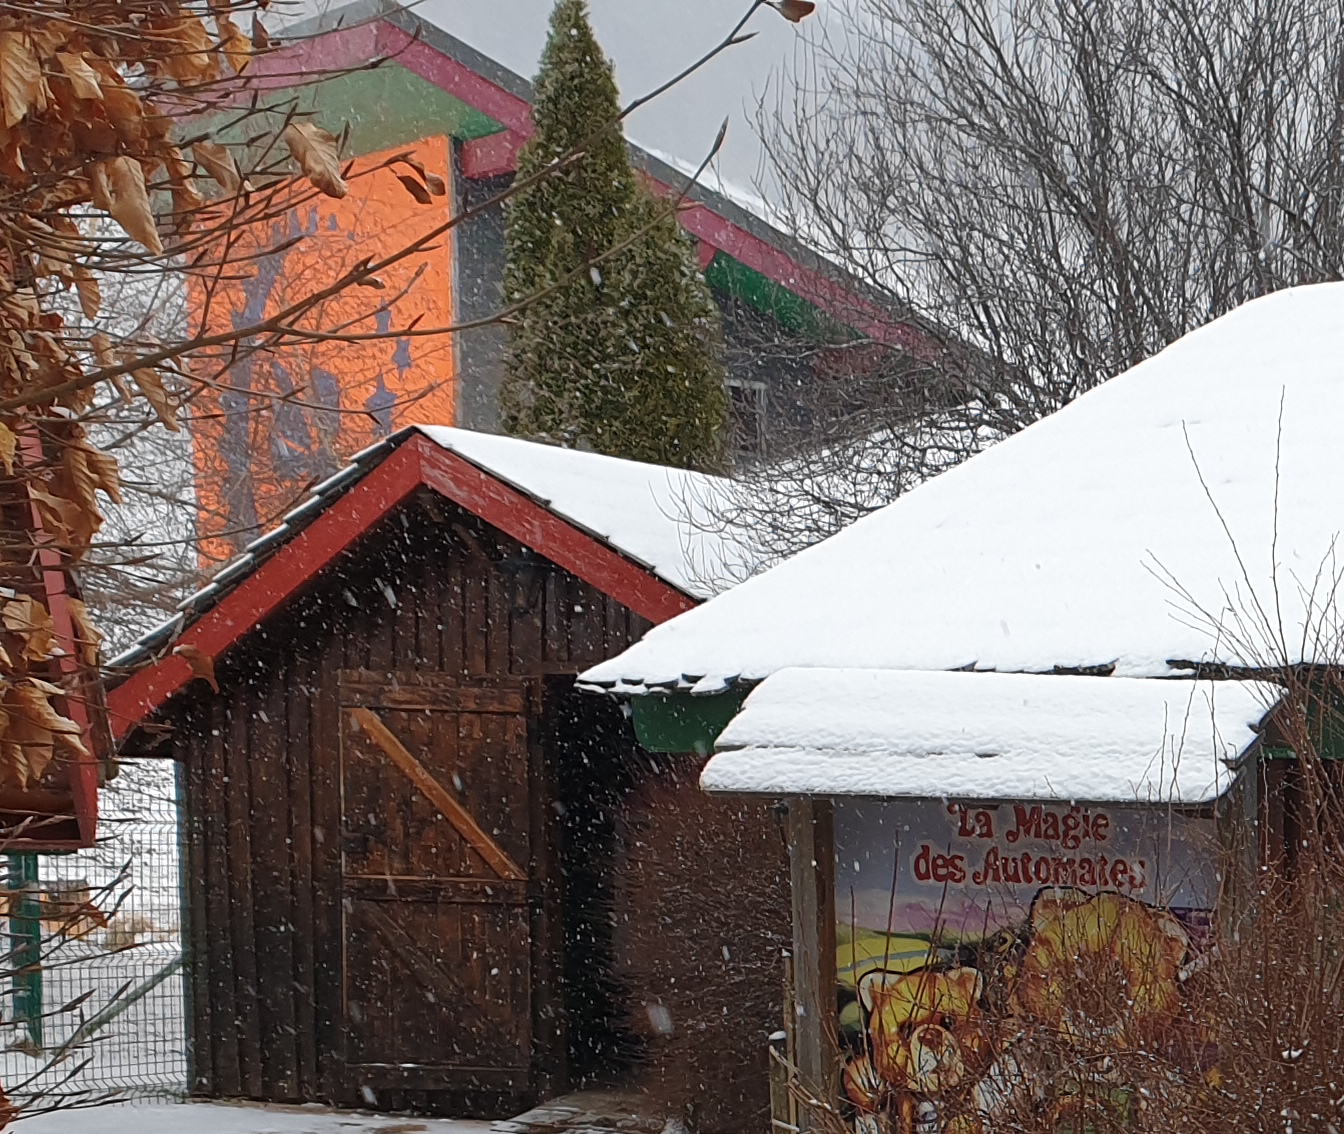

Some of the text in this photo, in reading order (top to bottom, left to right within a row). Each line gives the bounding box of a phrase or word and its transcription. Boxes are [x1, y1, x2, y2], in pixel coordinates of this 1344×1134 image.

[947, 803, 1110, 849] La Magie
[914, 845, 1147, 889] des Automates
